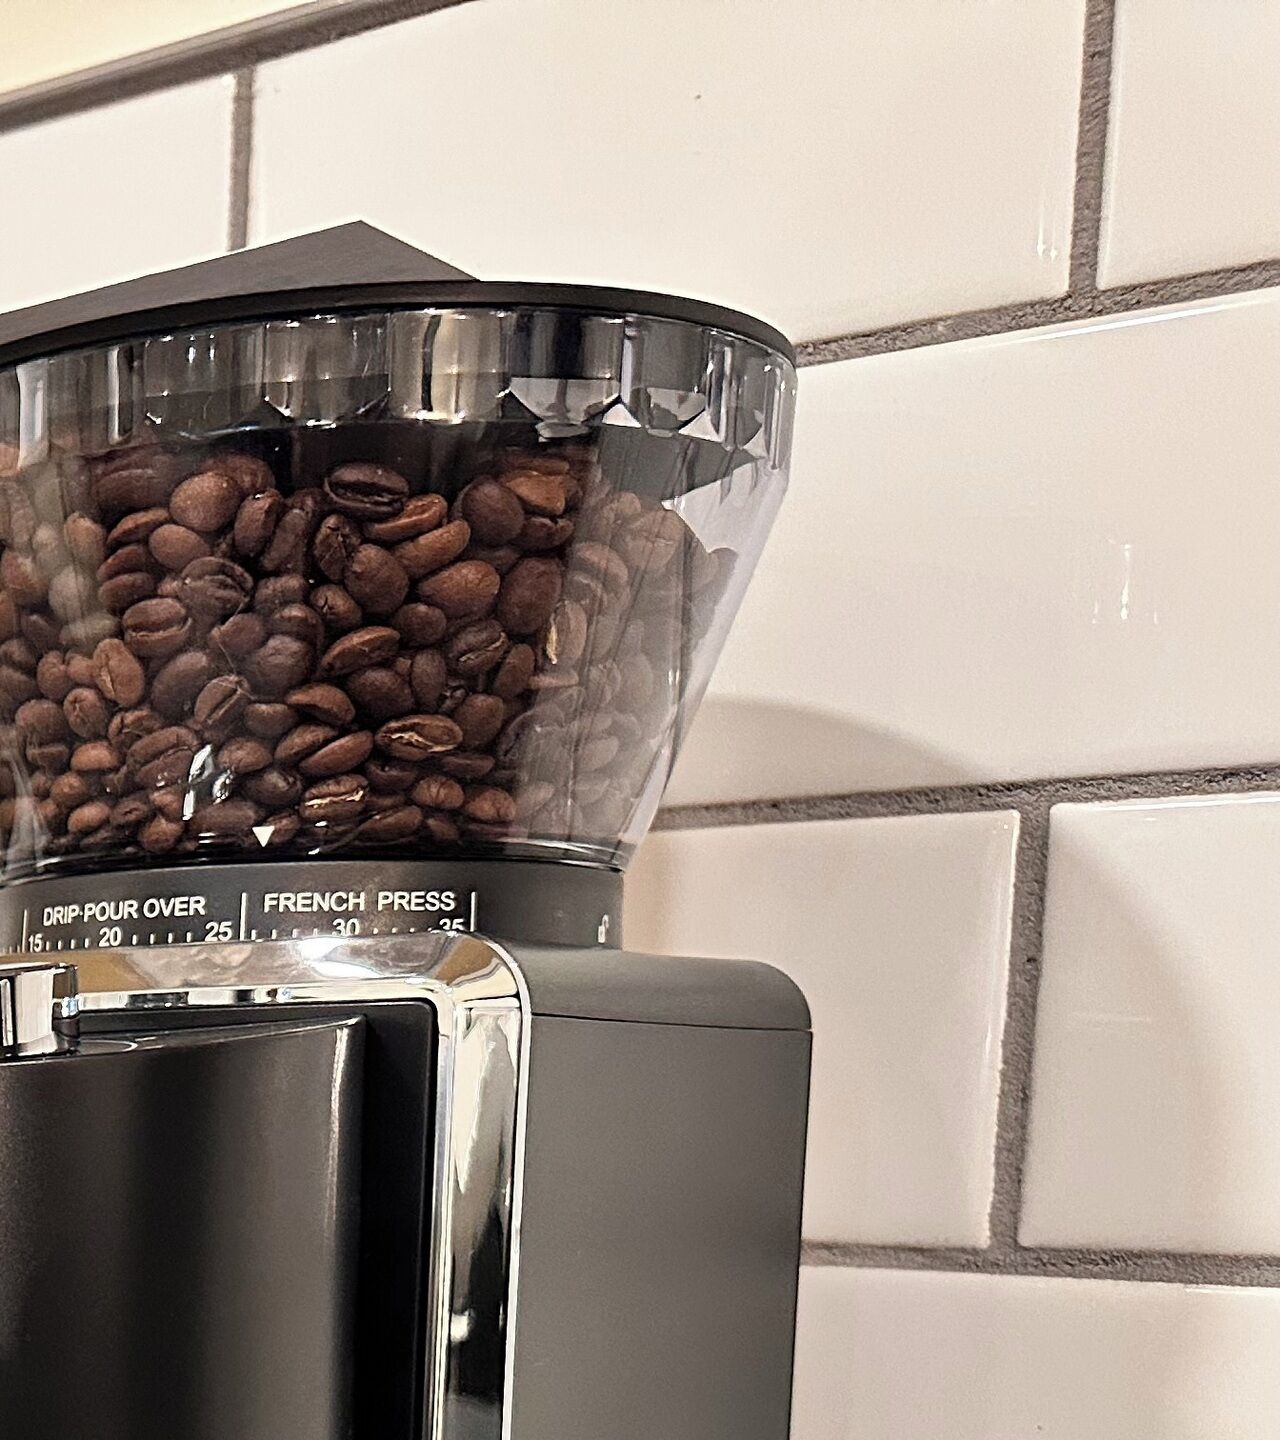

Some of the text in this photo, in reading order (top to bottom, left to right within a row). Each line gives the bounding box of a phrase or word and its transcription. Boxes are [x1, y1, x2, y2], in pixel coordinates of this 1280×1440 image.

[143, 896, 206, 919] OVER
[263, 891, 456, 914] FRENCH PRESS
[28, 933, 43, 953] 15
[98, 926, 123, 948] 20
[204, 921, 234, 942] 25
[332, 918, 361, 936] 30
